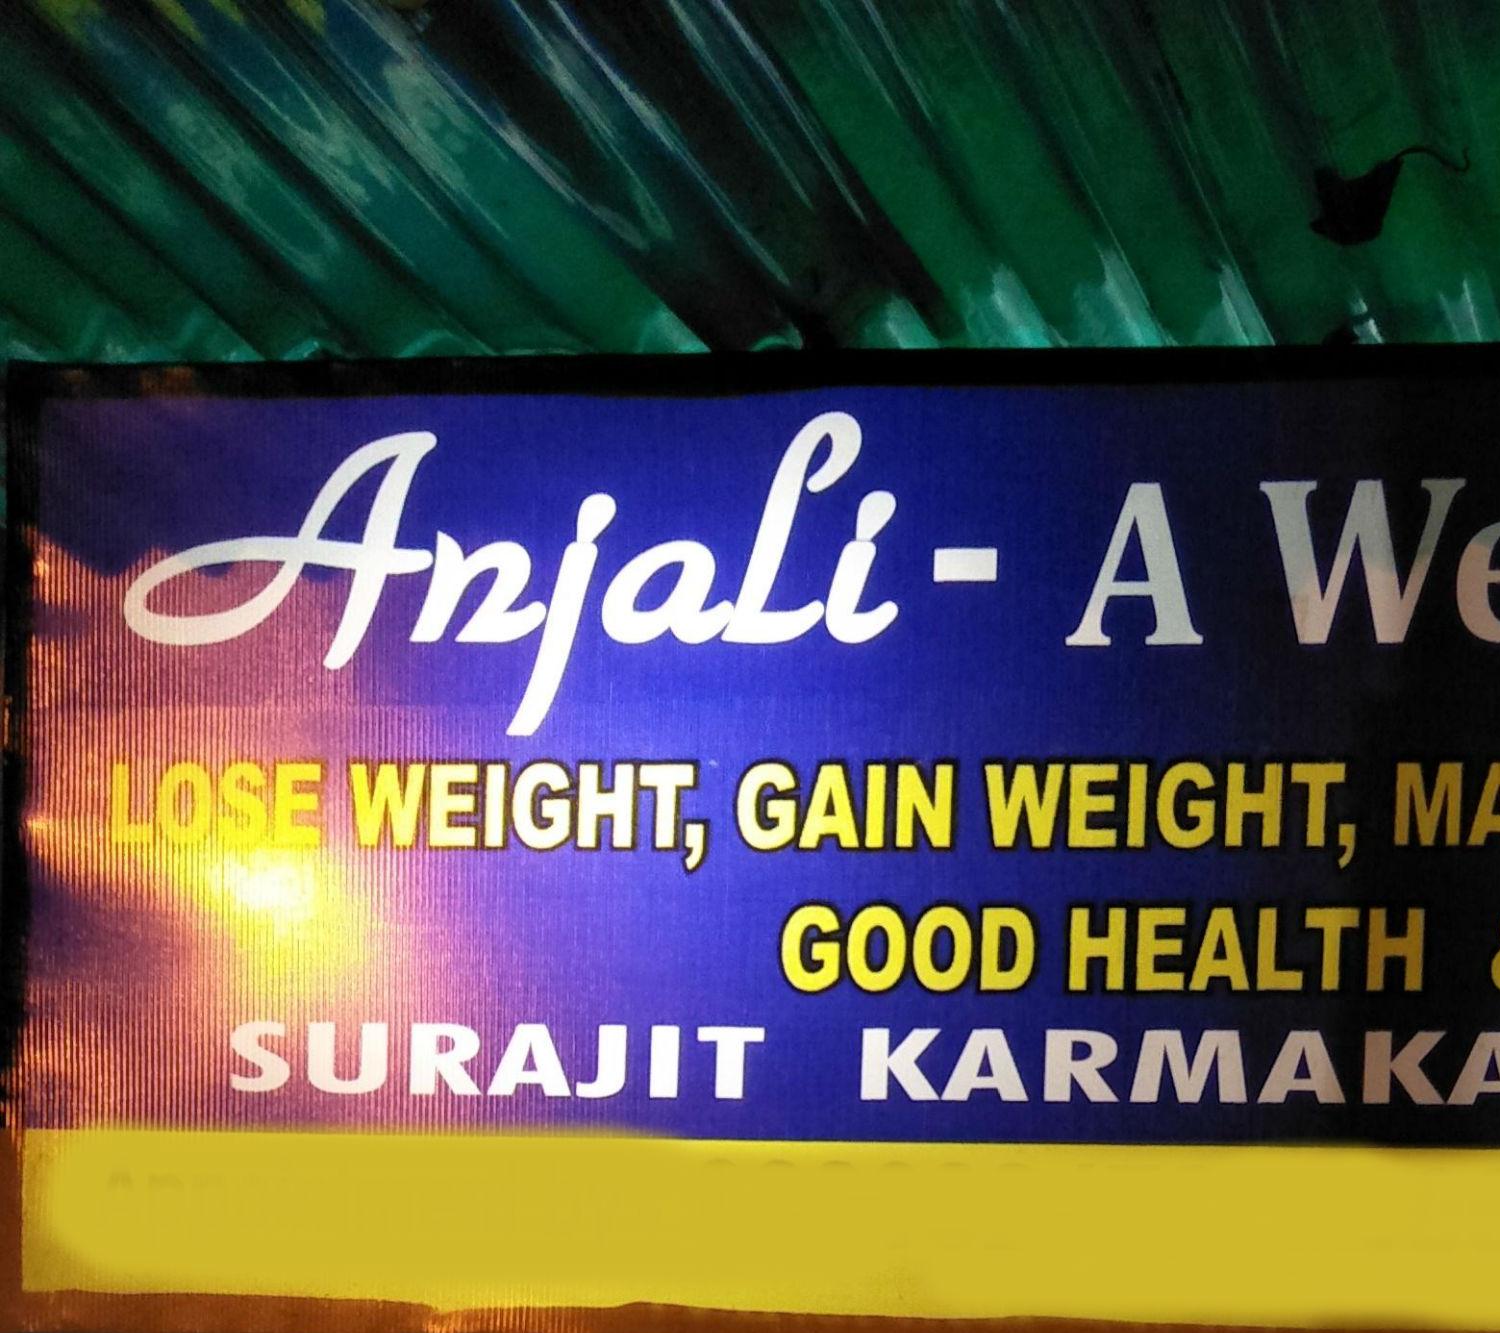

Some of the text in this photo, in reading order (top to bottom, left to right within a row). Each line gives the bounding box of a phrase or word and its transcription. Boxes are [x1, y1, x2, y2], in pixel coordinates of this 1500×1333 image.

[1066, 481, 1204, 647] A
[110, 760, 323, 849] LOSE
[349, 761, 710, 872] WEIGHT,
[737, 762, 953, 852] GAIN
[987, 761, 1357, 870] WEIGHT,
[781, 905, 1037, 993] GOOD
[1068, 906, 1426, 993] HEALTH
[228, 1020, 765, 1100] SURAJIT
